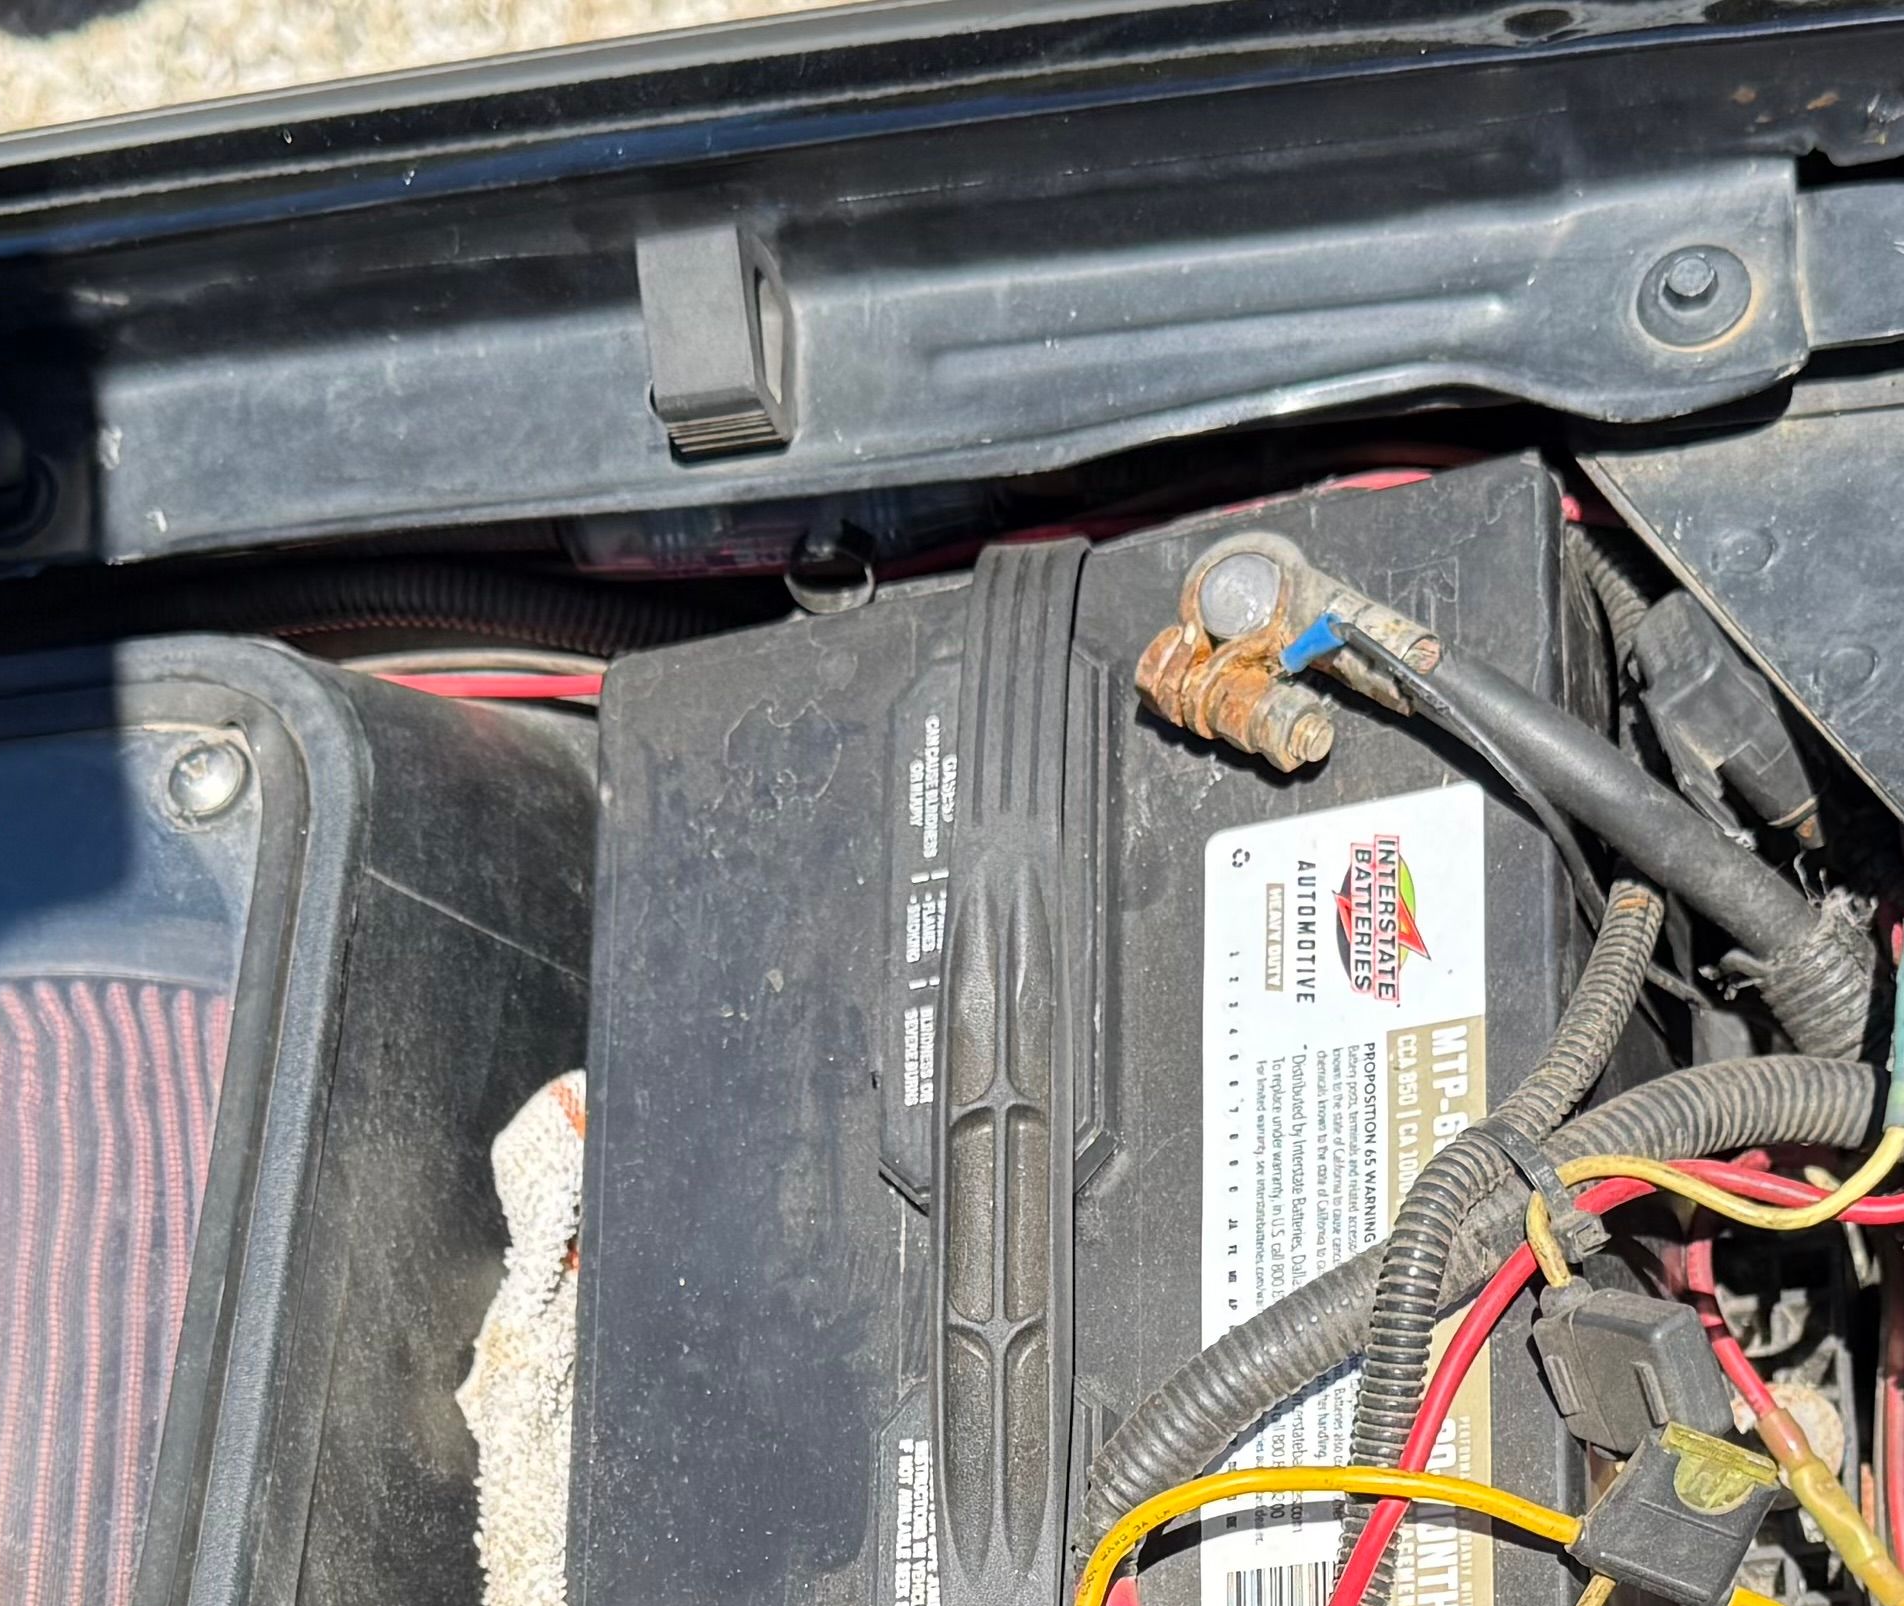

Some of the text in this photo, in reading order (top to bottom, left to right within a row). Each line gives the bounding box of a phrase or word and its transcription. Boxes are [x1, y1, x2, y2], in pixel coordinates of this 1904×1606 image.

[1266, 887, 1280, 986] HEAVY DUTY
[1296, 860, 1315, 1002] AUTOMOTIVE
[1354, 849, 1371, 989] BATTERIES
[1377, 840, 1395, 997] INTERSTATE
[1396, 1034, 1417, 1068] CCA
[1269, 1073, 1284, 1113] replace
[1291, 1054, 1306, 1120] Distributed
[1394, 1069, 1417, 1106] 850
[1271, 1116, 1283, 1148] under
[1288, 1122, 1306, 1137] by
[1363, 1042, 1376, 1243] PROPOSITION 65 WARNING
[1397, 1122, 1417, 1147] CA
[1291, 1139, 1305, 1194] Interstate
[1270, 1242, 1284, 1260] call
[1290, 1197, 1306, 1251] Batteries,
